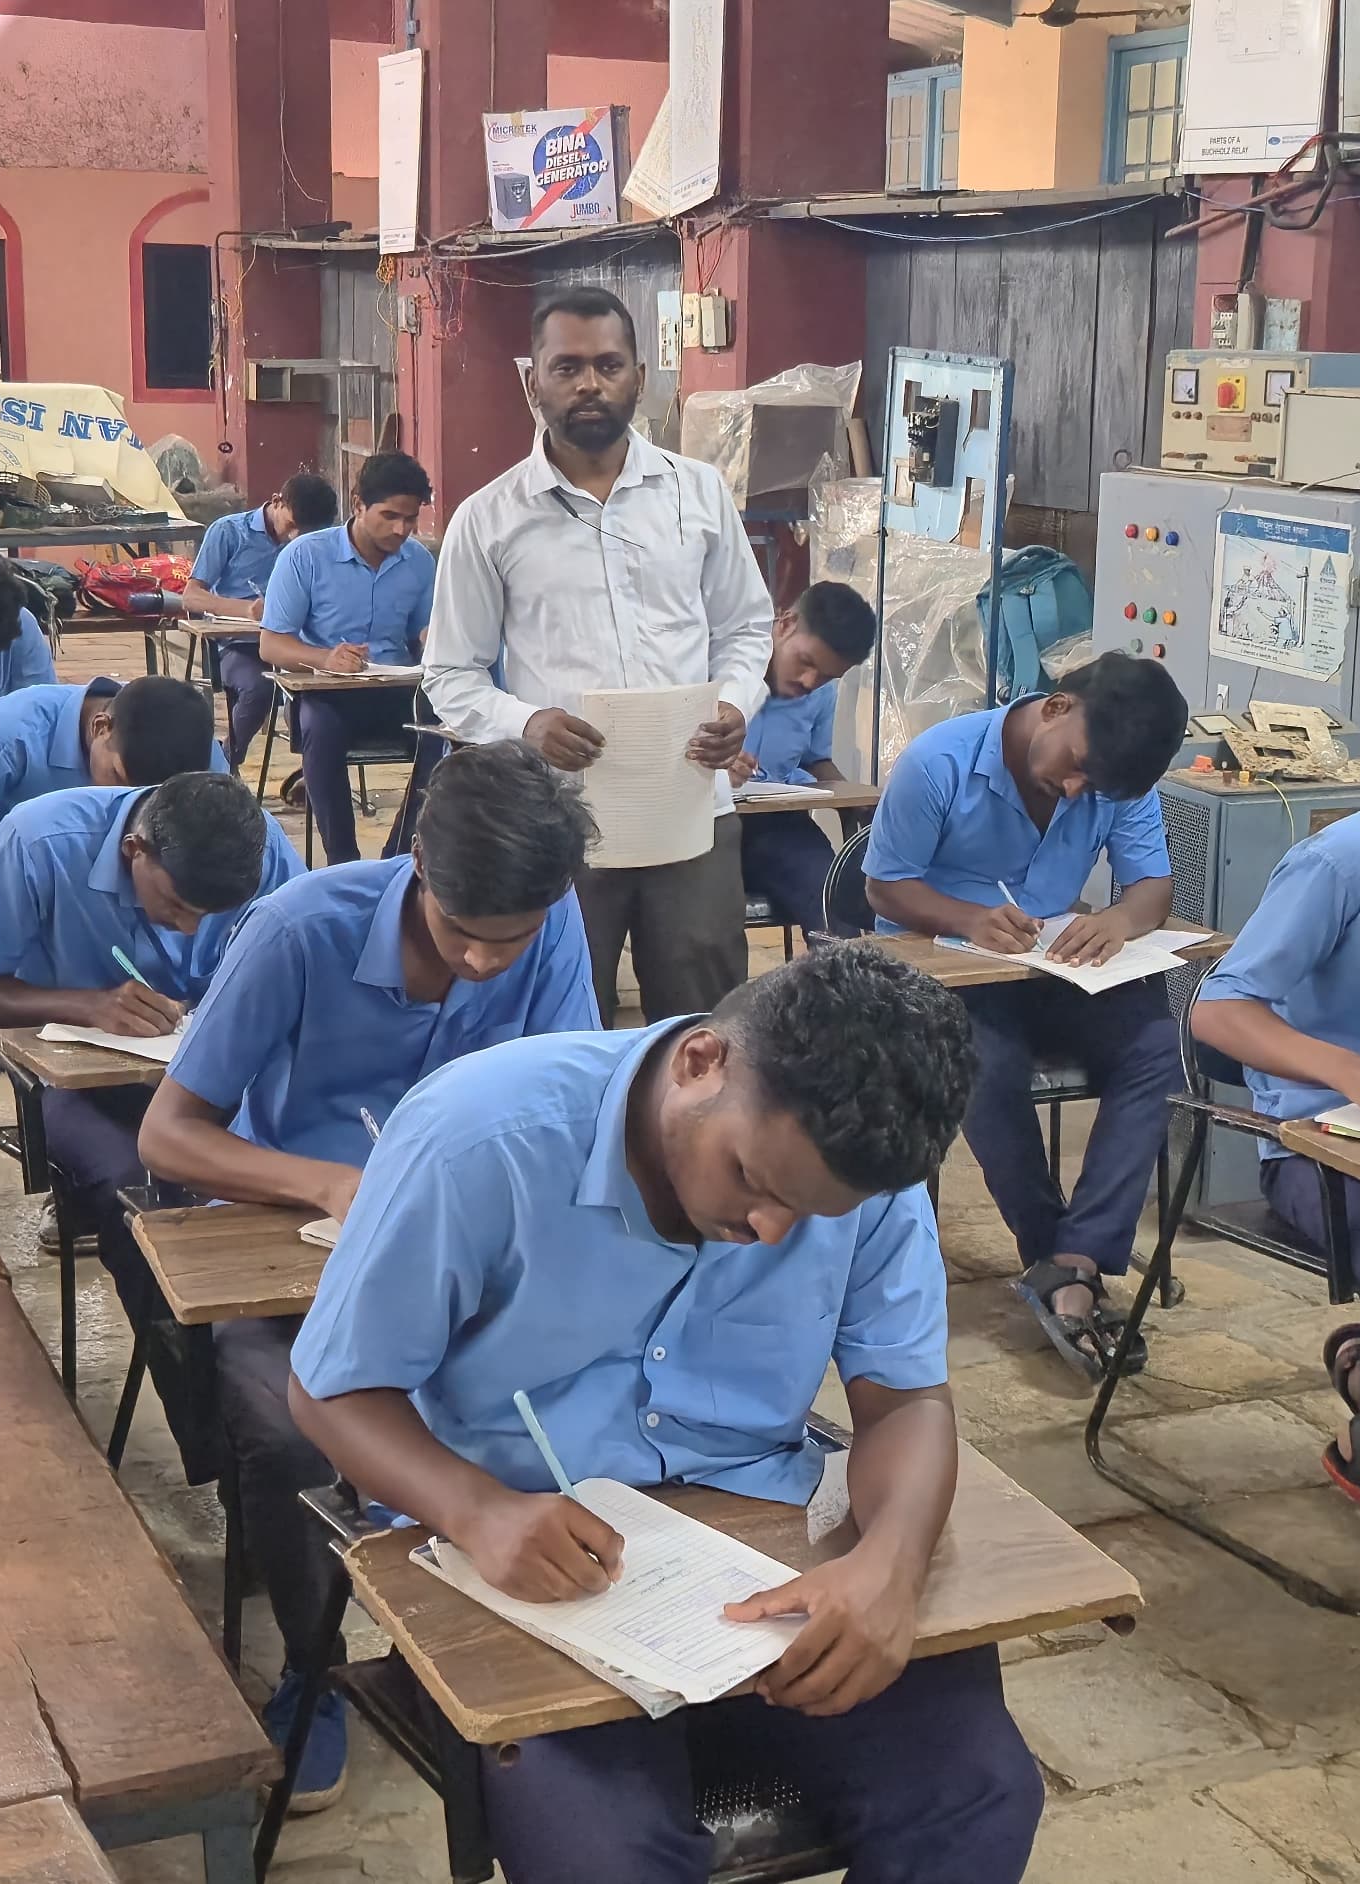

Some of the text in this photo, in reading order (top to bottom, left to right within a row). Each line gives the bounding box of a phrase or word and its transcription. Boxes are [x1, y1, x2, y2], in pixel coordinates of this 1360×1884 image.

[545, 132, 586, 157] BINA
[1209, 137, 1227, 145] PARTS
[1232, 146, 1249, 154] RELAY
[545, 151, 581, 169] DIESEL
[535, 159, 609, 186] GENERATOR
[570, 202, 600, 218] JUMBO
